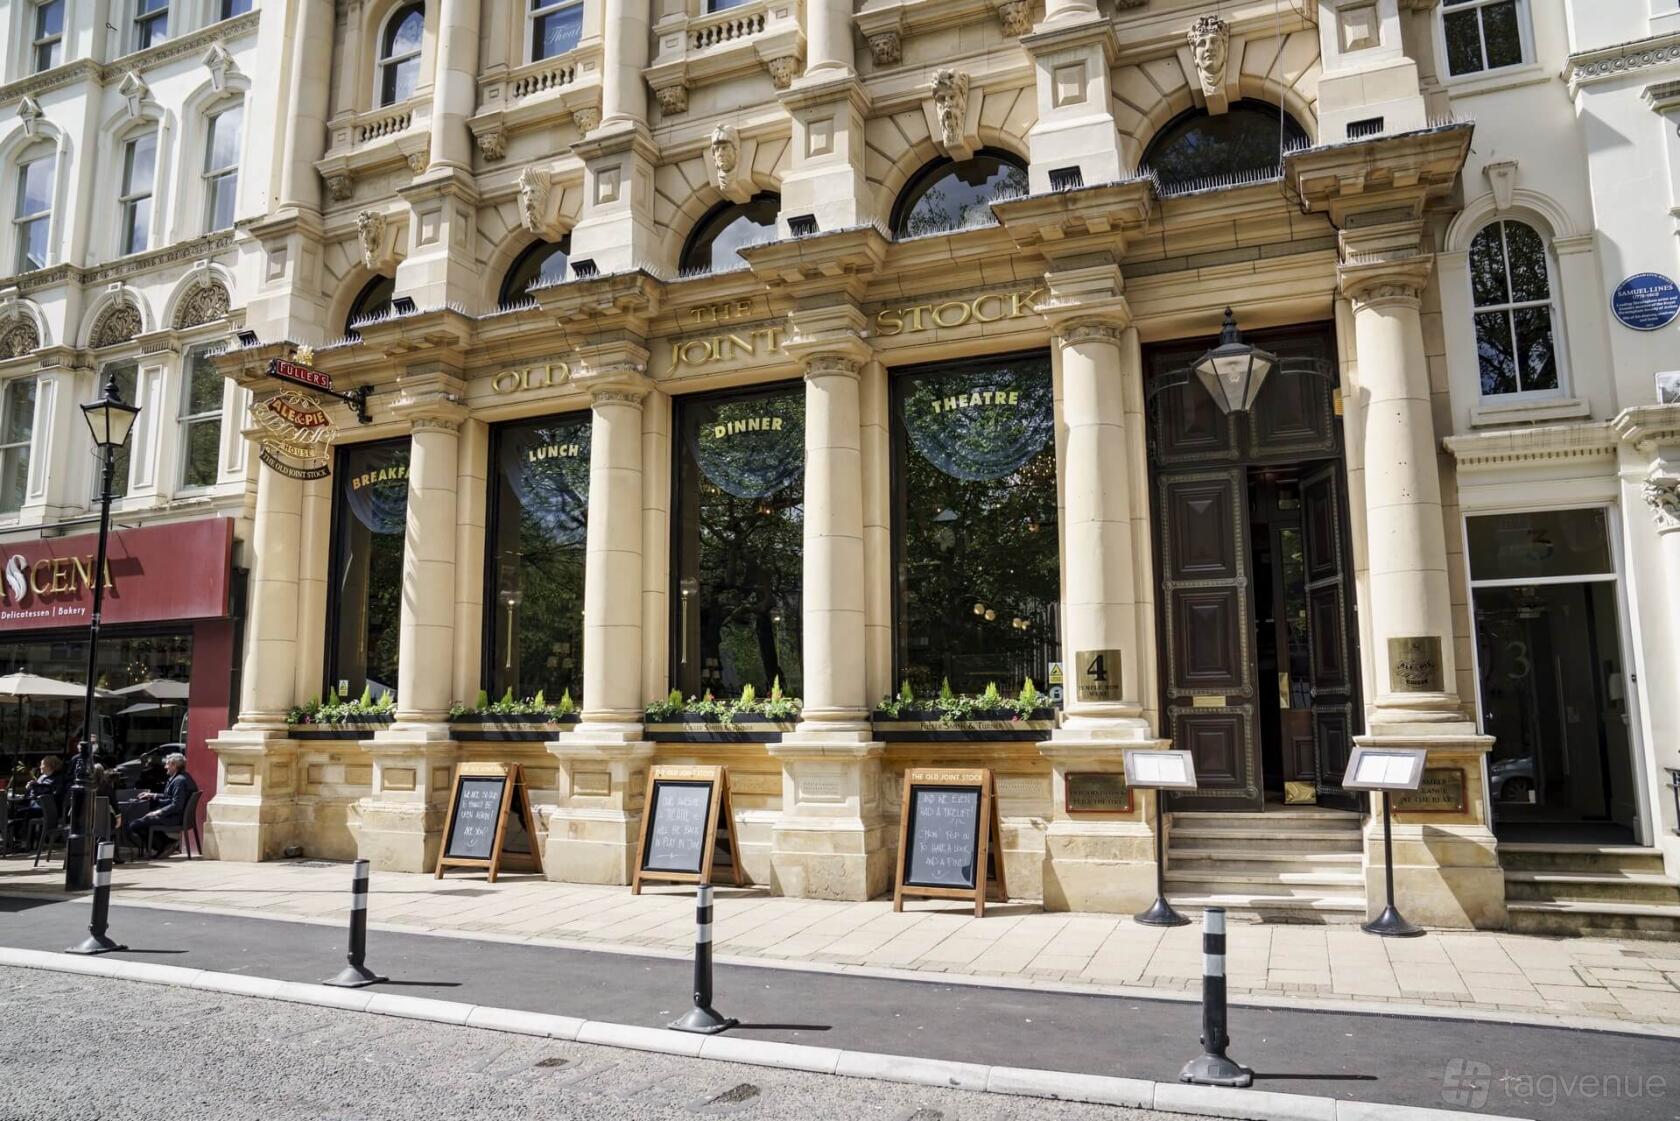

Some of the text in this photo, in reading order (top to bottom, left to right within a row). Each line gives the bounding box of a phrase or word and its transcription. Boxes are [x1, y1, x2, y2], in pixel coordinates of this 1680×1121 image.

[689, 300, 751, 322] THE
[491, 288, 1044, 395] OLD JOINT STOCK
[931, 391, 1019, 414] THEATRE
[714, 417, 783, 439] DINNER
[529, 445, 578, 462] LUNCH
[289, 469, 306, 478] JOINT
[307, 469, 327, 478] STOCK
[1, 607, 86, 620] Delicatessen Bakery
[1087, 654, 1108, 682] 4
